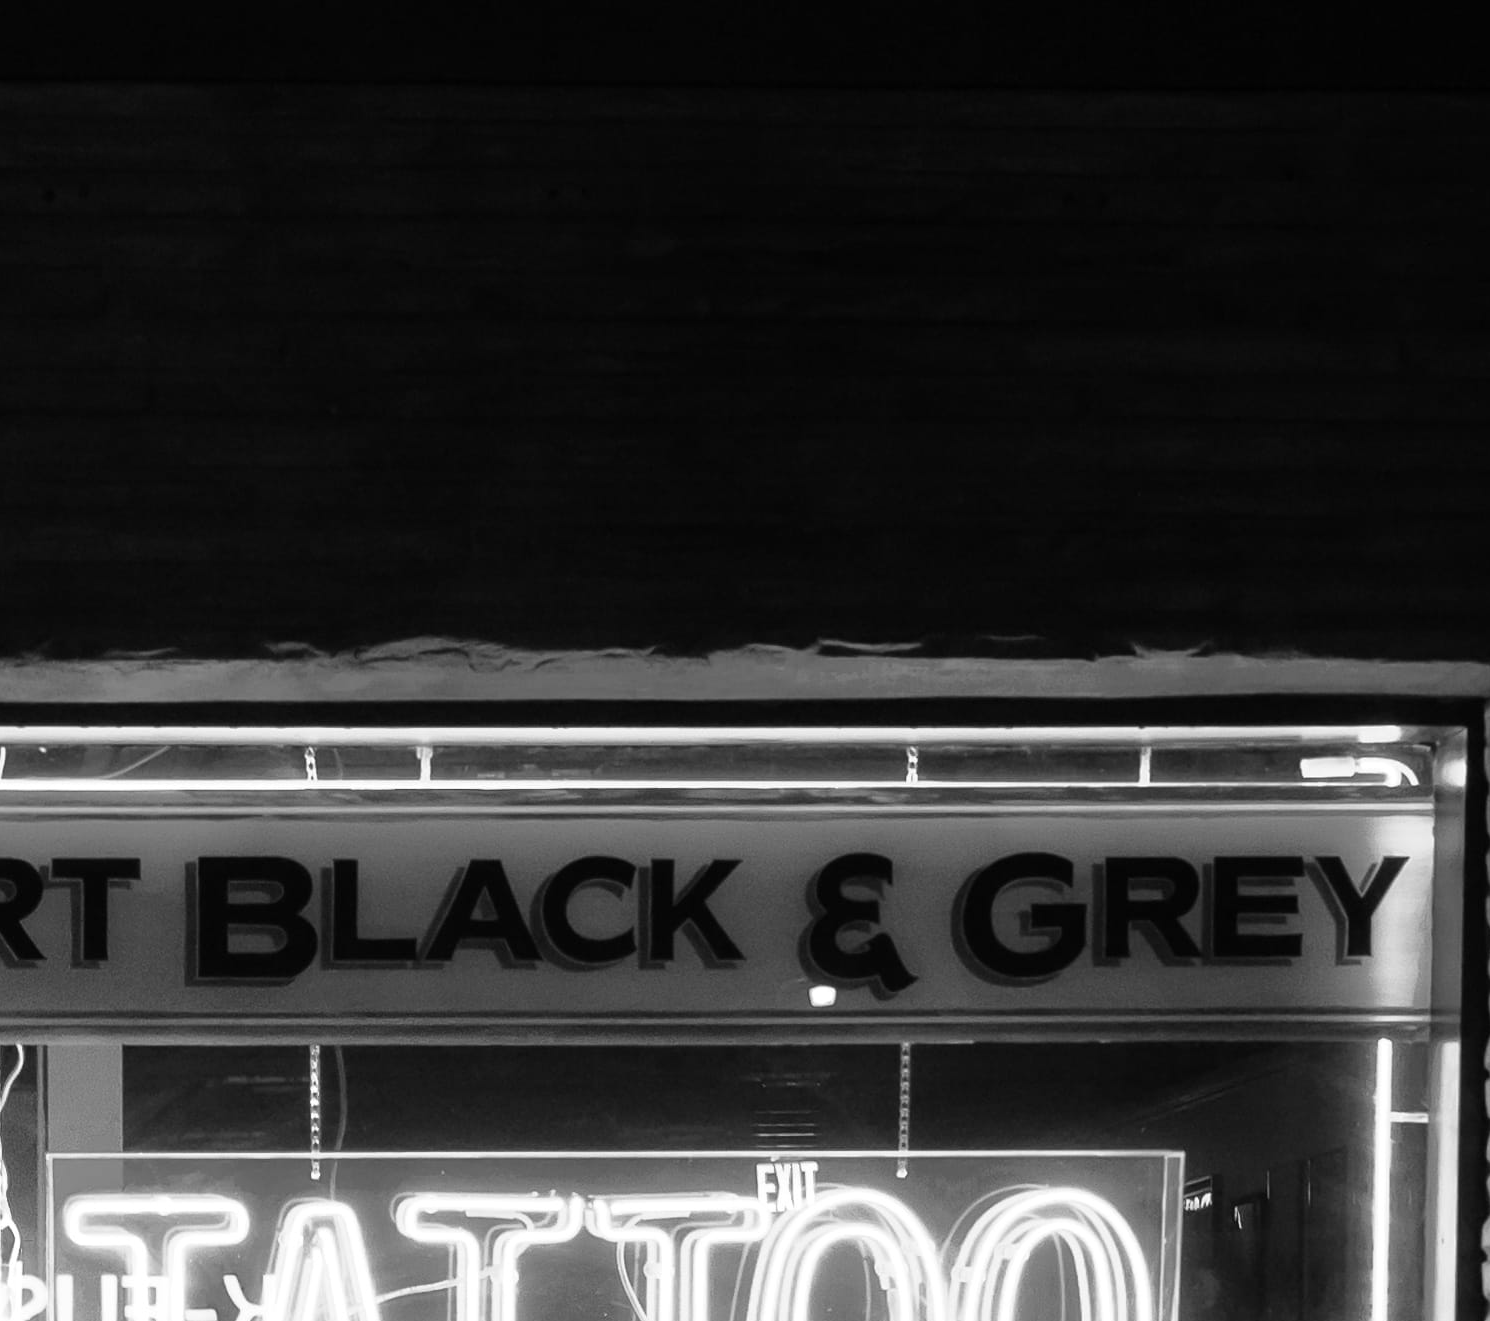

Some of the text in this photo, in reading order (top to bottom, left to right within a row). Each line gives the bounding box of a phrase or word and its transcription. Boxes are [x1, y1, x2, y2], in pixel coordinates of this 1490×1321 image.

[183, 852, 744, 988] BLACK
[797, 852, 919, 1000] &
[950, 851, 1411, 988] GREY
[754, 1160, 819, 1213] EXIT
